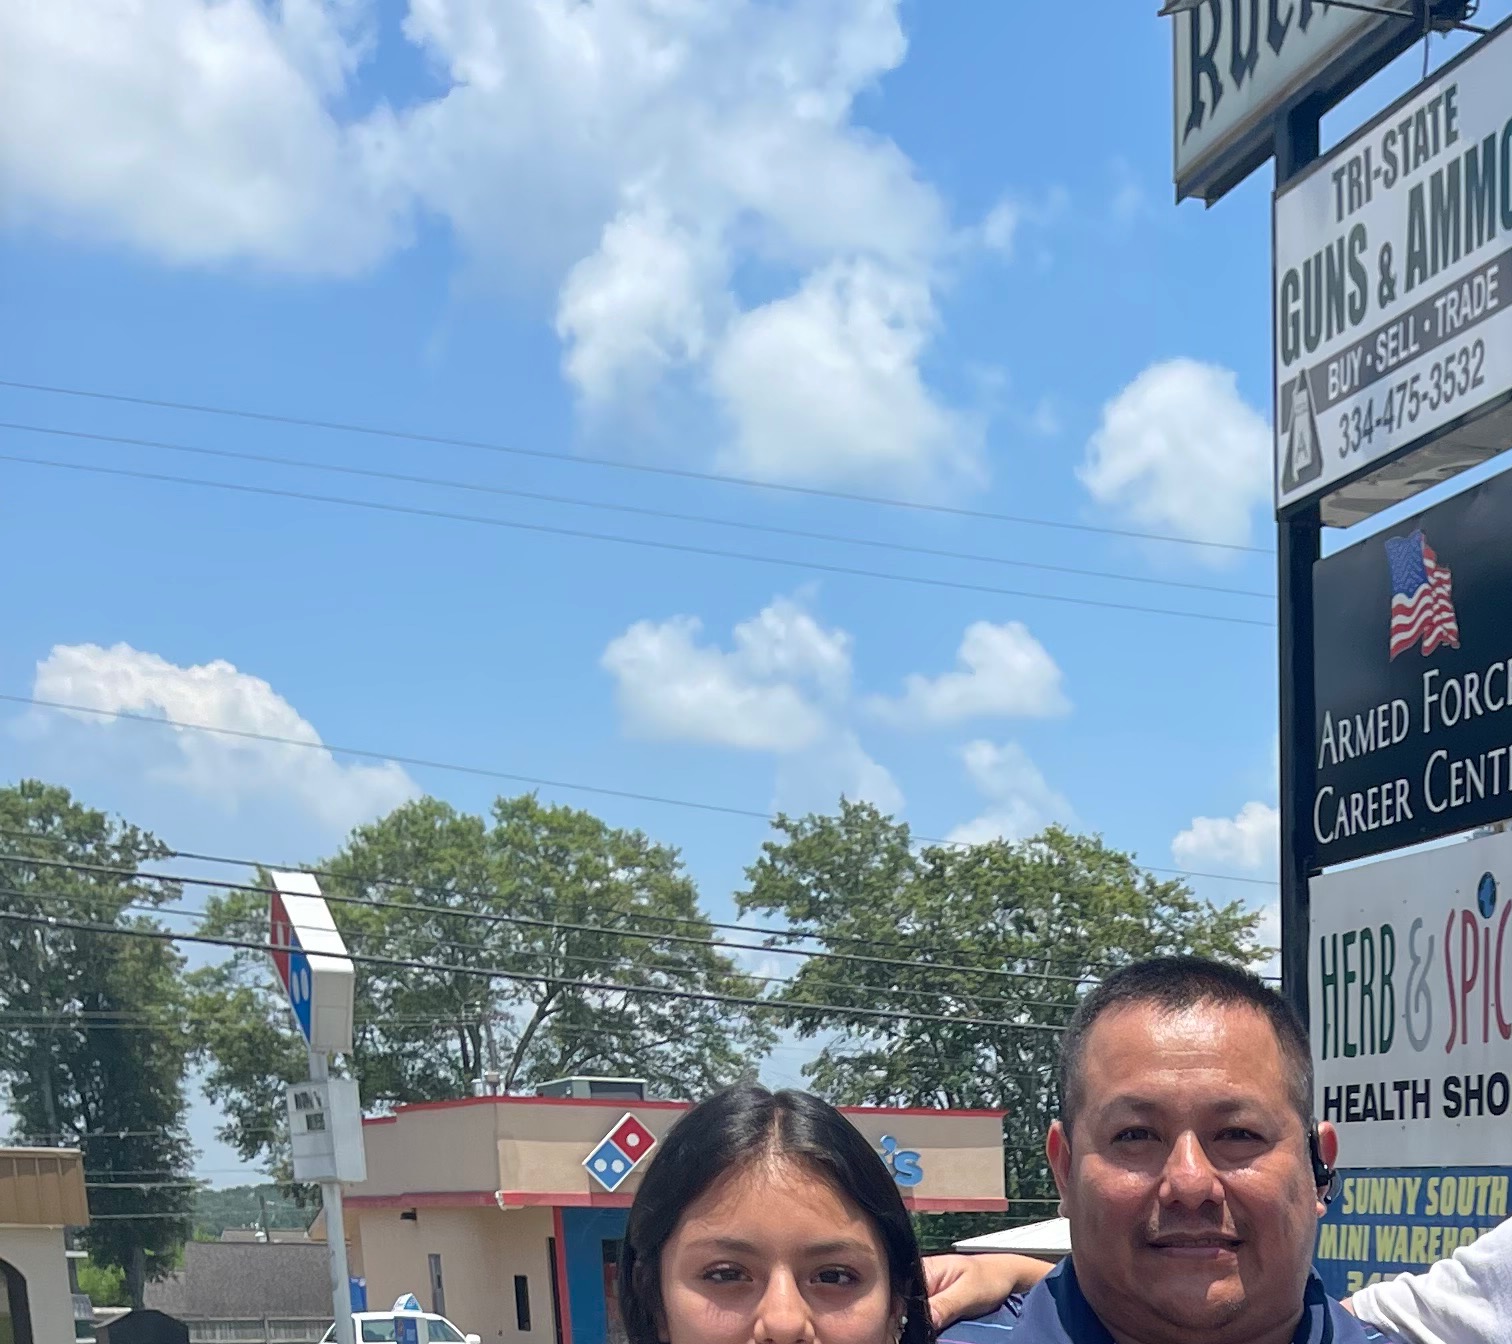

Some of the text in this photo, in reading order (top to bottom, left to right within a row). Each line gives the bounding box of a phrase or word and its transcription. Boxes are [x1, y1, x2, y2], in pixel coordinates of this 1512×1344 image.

[1332, 84, 1459, 223] TRI-STATE
[1281, 223, 1368, 367] GUNS
[1378, 241, 1397, 309] &
[1327, 265, 1499, 400] BUY SELL TRADE
[1338, 337, 1485, 459] 334-475-3532
[1317, 710, 1410, 769] ARMED
[1313, 777, 1413, 844] CAREER
[1320, 923, 1396, 1061] HERB
[1405, 916, 1435, 1053] &
[1323, 1078, 1431, 1123] HEALTH
[1317, 1223, 1370, 1261] MINI
[1342, 1175, 1509, 1217] SUNNY SOUTH
